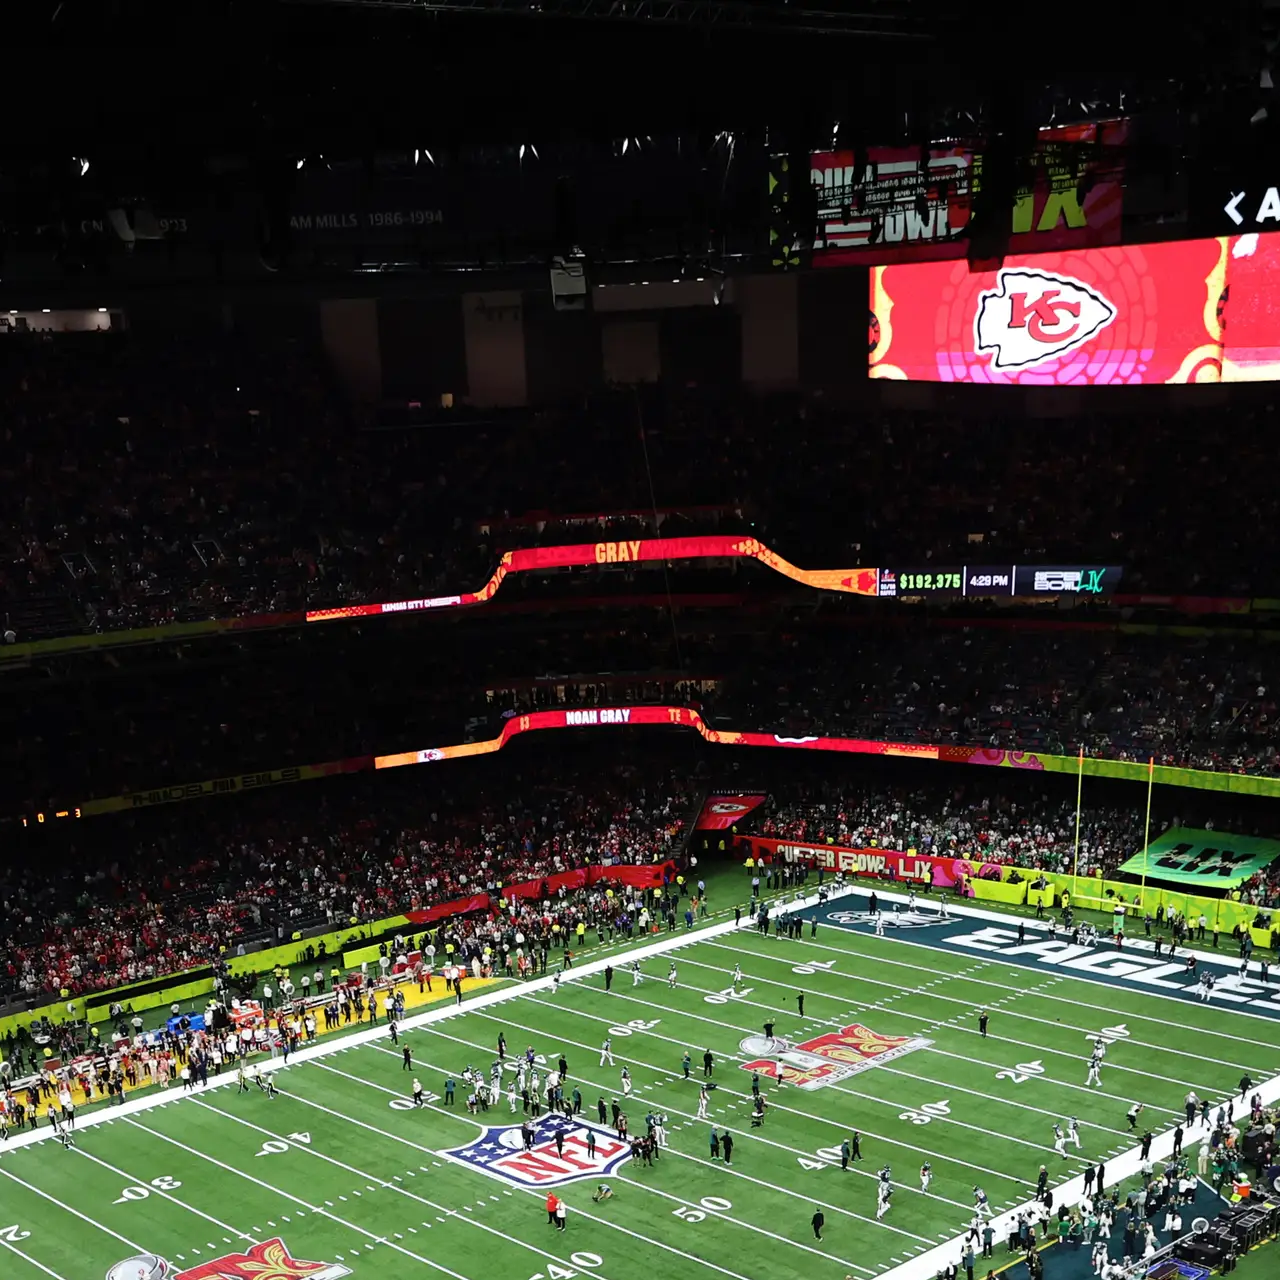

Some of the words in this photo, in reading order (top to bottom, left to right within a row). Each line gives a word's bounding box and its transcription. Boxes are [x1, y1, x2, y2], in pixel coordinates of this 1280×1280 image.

[595, 541, 641, 563] GRAY
[992, 578, 1008, 586] PM
[566, 711, 598, 725] NOAH
[600, 709, 630, 723] GRAY
[668, 708, 681, 722] TE
[817, 1061, 868, 1084] SUPER
[995, 1063, 1044, 1083] 20
[899, 1103, 950, 1125] 30
[497, 1133, 625, 1182] NFL
[122, 1176, 181, 1200] 30
[673, 1197, 731, 1223] 50
[547, 1252, 602, 1280] 40
